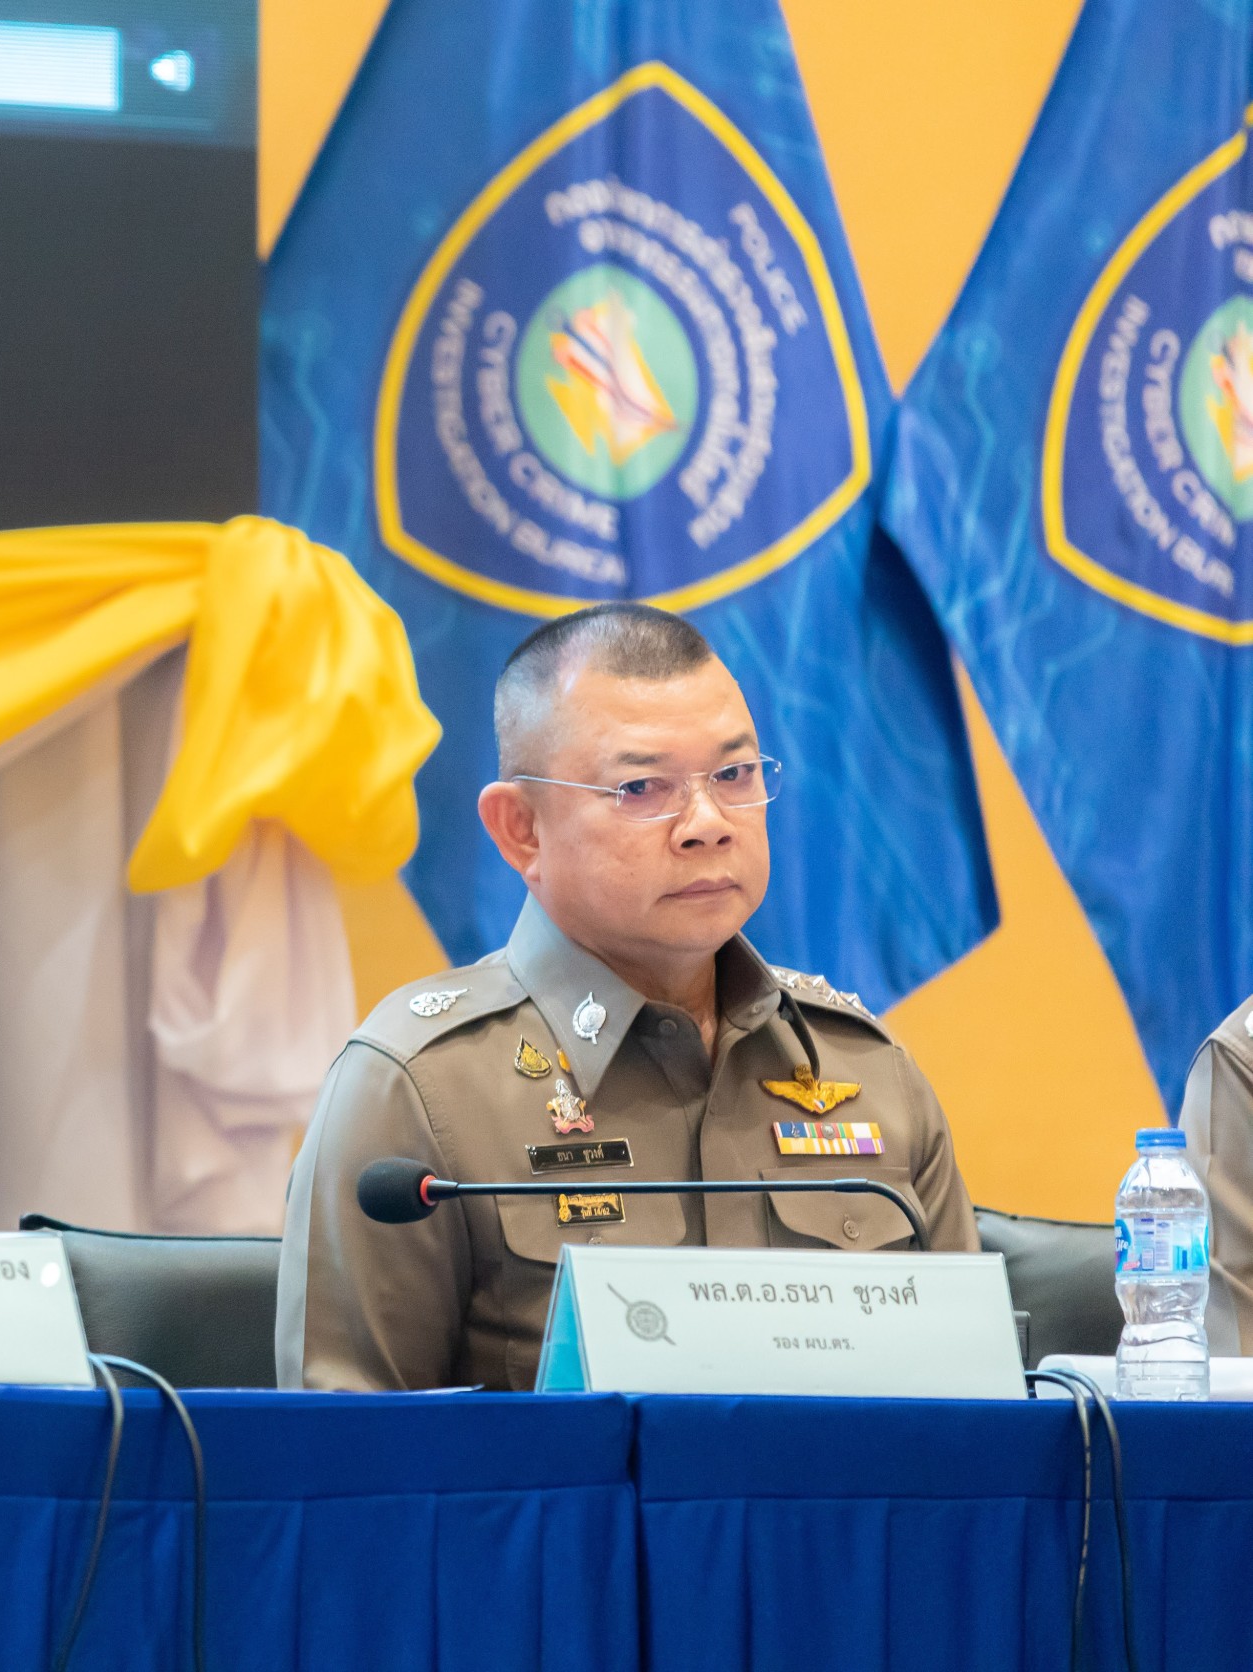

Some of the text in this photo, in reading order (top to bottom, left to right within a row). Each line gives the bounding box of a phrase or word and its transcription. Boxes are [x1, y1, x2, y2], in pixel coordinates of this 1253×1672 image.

[729, 201, 808, 335] POLICE
[476, 309, 523, 456] CYBER
[1142, 328, 1184, 472] CYBER
[688, 1275, 919, 1316] พล.ต.อ.ธนา ชูวงศ์
[772, 1336, 856, 1352] รอง ผบ.ตร.
